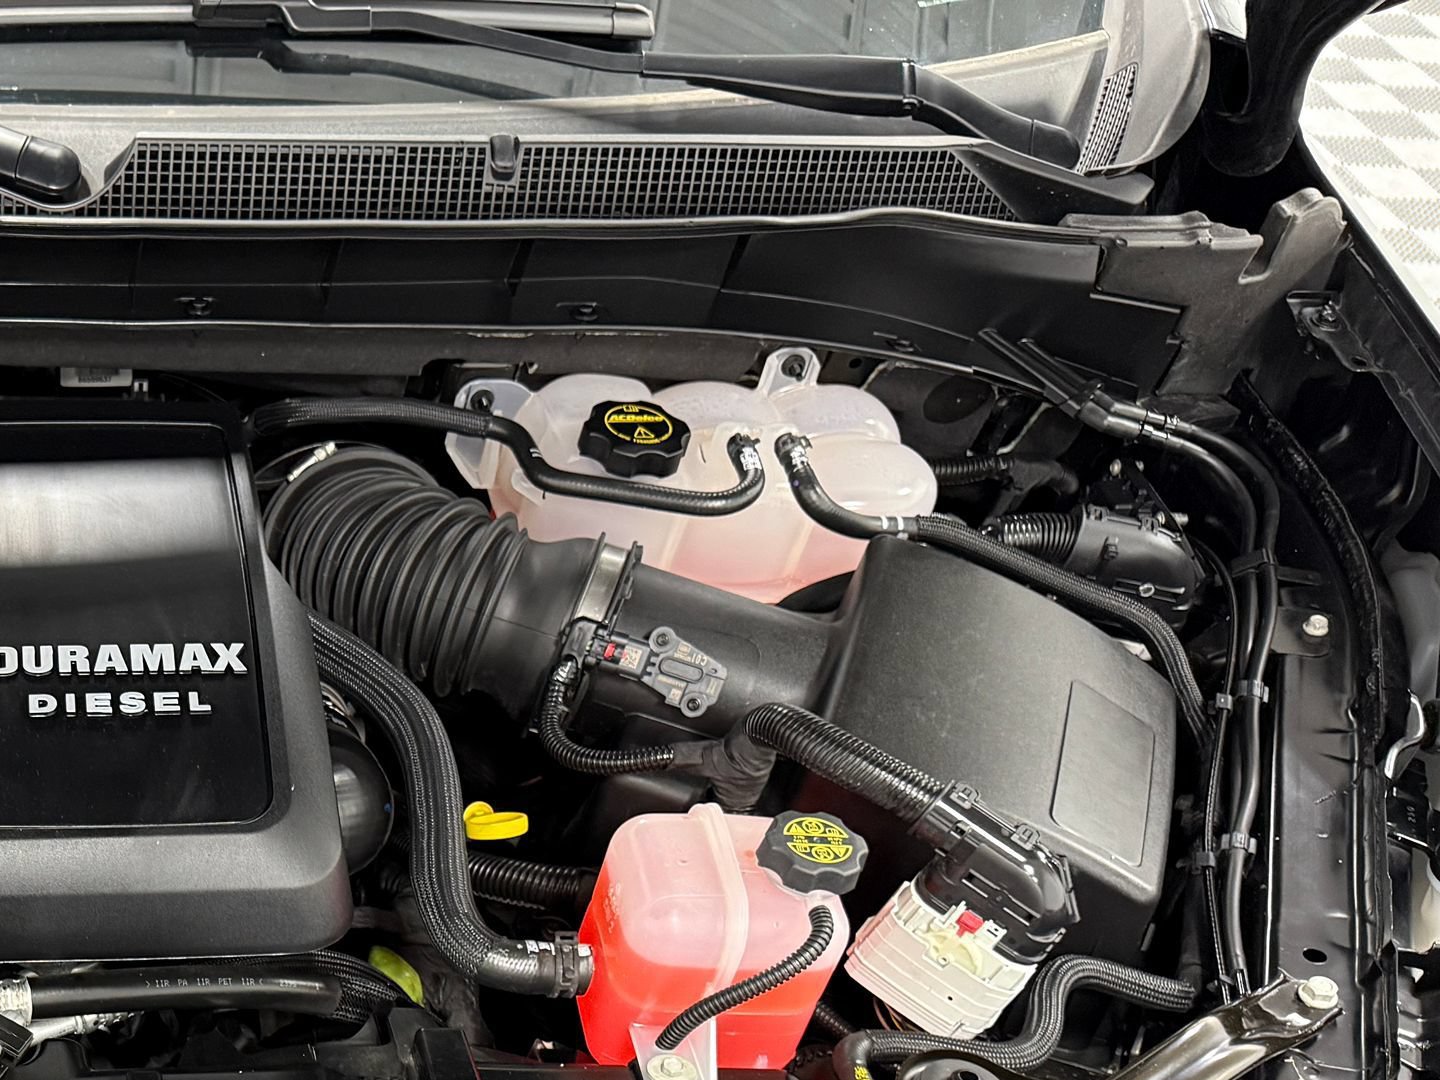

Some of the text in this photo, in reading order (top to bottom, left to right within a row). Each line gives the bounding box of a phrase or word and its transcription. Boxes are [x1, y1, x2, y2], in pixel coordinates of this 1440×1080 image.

[607, 413, 665, 424] ACDelco
[27, 691, 213, 717] DIESEL
[218, 977, 233, 986] PET
